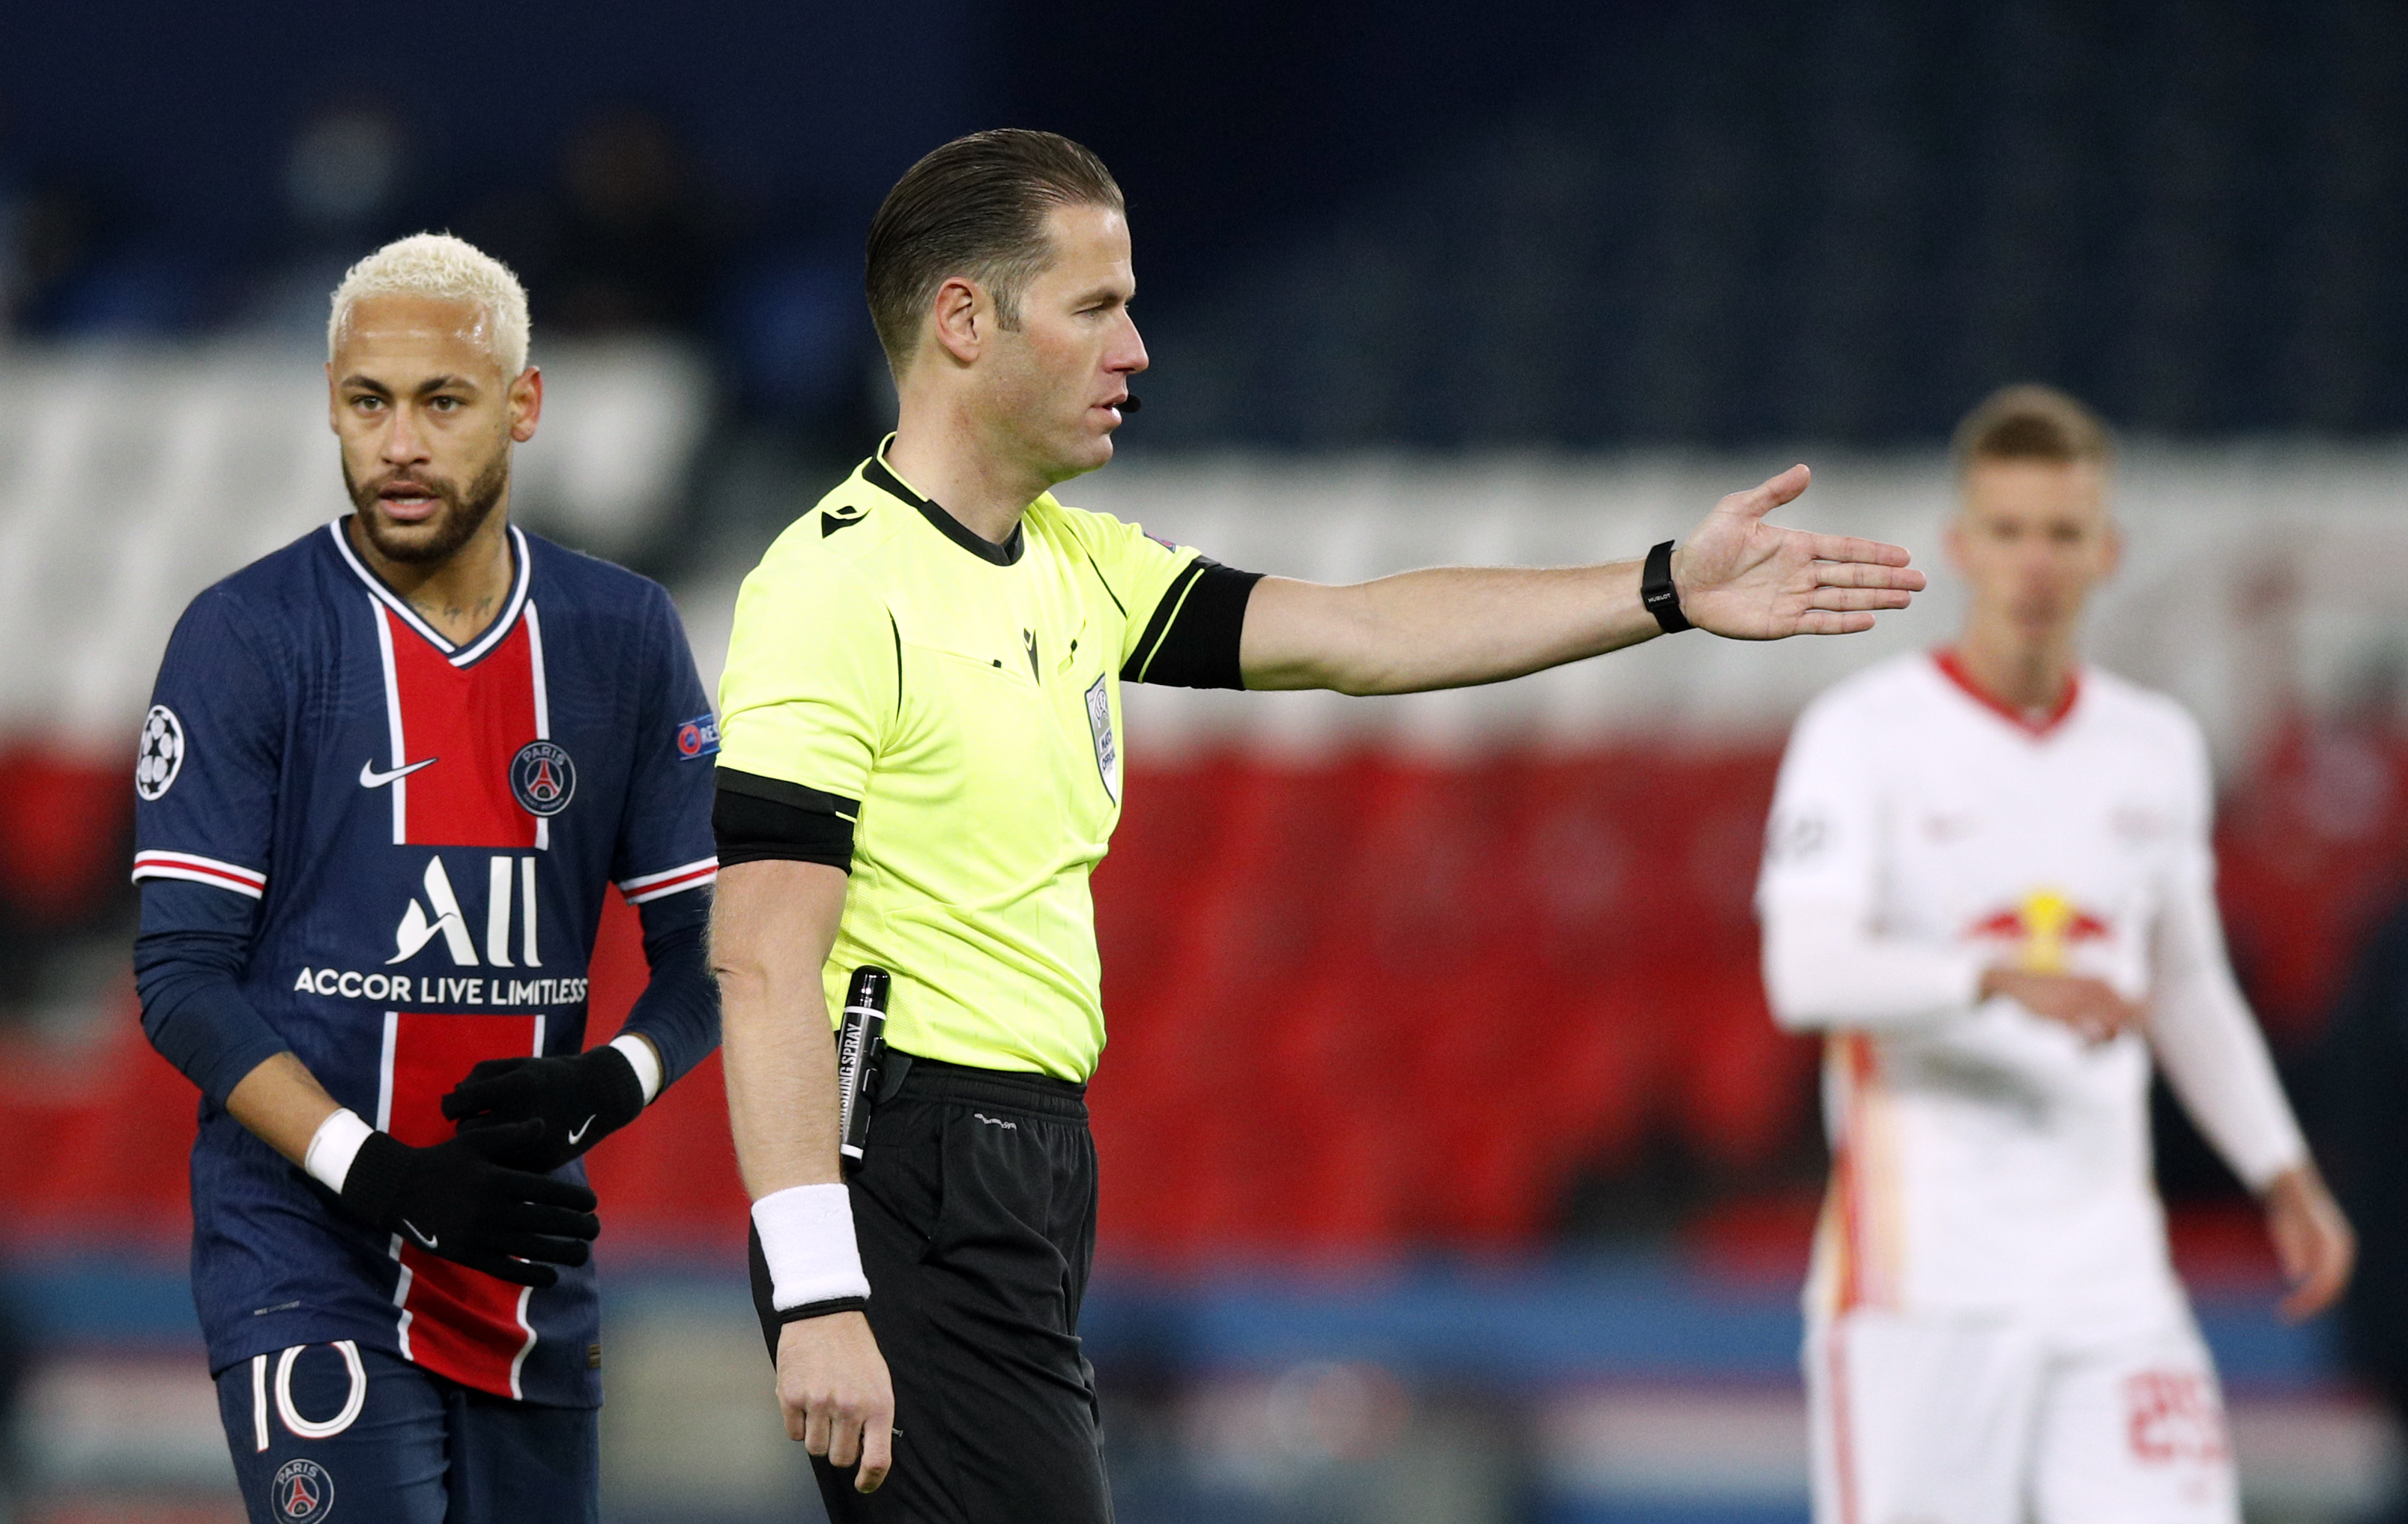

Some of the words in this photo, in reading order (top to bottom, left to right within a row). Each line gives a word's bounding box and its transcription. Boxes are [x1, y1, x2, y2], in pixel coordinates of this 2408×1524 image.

[1648, 593, 1672, 603] HUBLOT
[701, 724, 721, 744] RES
[522, 746, 567, 766] PARIS
[294, 967, 412, 1000] ACCOR
[420, 976, 484, 1006] LIVE
[491, 977, 588, 1006] LIMITLESS
[841, 1023, 862, 1065] SPRAY
[252, 1340, 366, 1453] 10
[278, 1463, 318, 1485] PARIS
